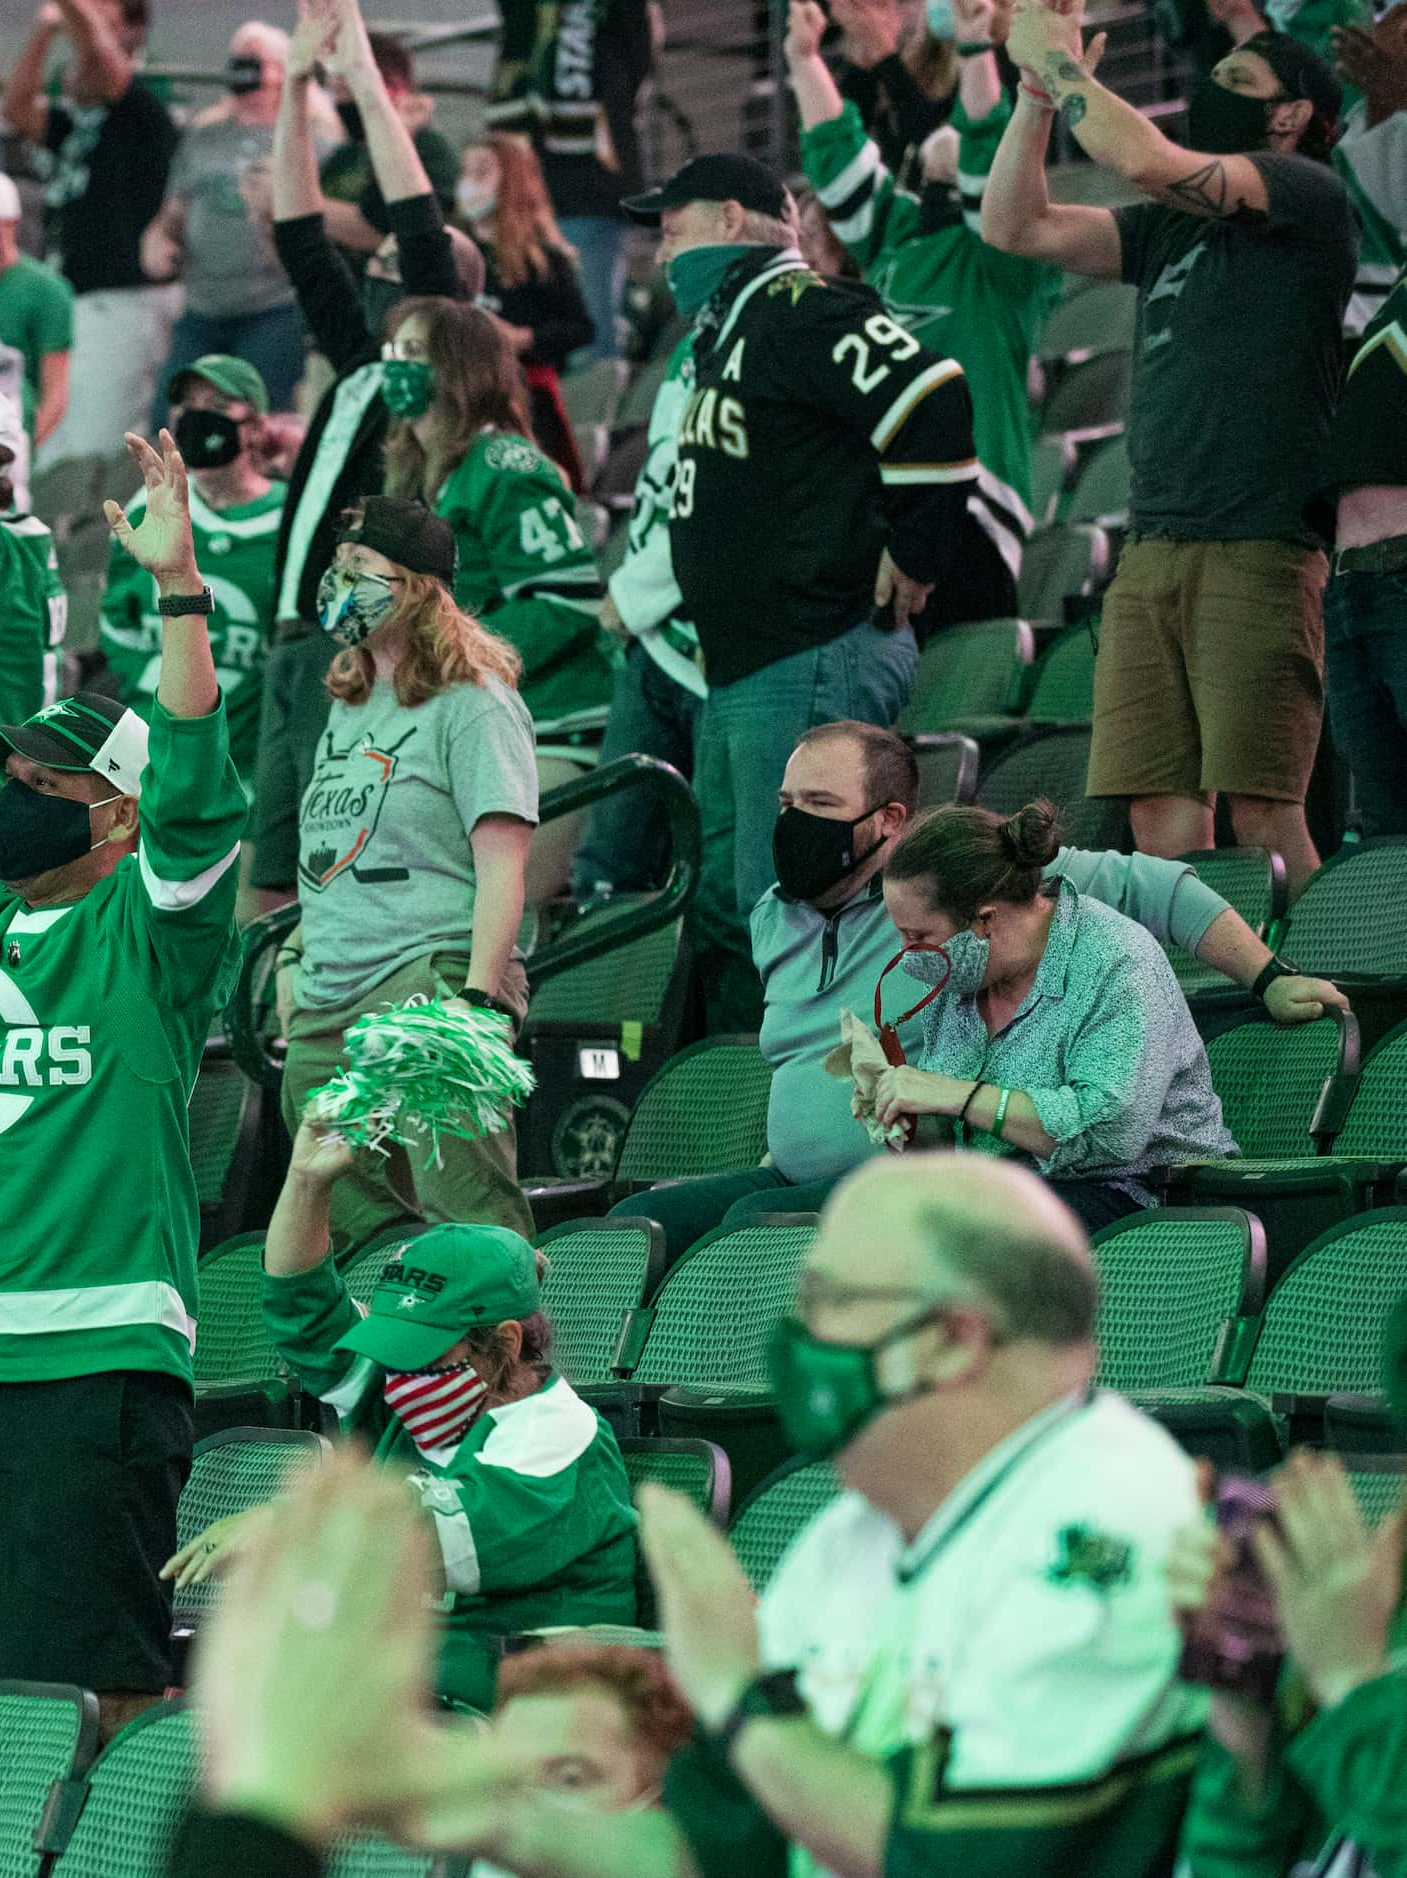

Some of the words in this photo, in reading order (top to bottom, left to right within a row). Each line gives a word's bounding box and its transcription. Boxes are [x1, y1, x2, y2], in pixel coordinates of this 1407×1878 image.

[722, 337, 745, 382] A
[833, 315, 920, 394] 29
[302, 773, 374, 823] Texas
